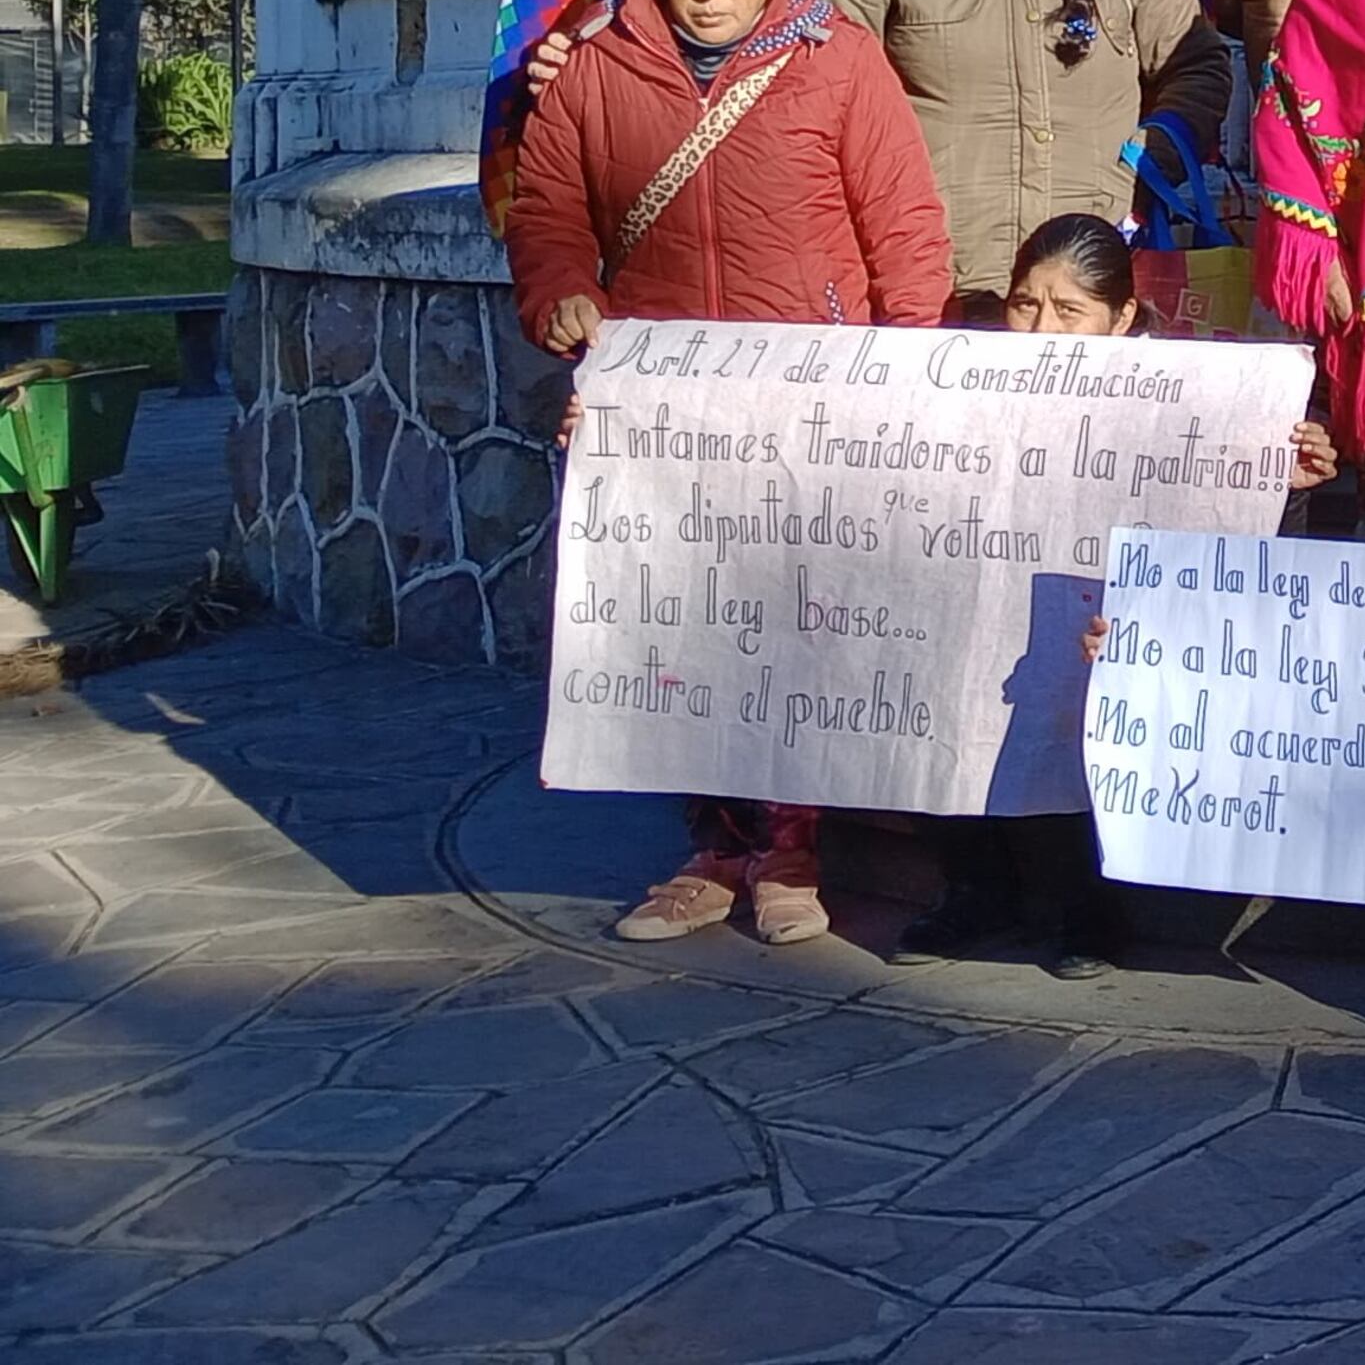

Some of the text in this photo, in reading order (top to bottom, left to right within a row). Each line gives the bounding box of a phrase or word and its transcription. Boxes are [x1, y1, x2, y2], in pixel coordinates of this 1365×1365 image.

[599, 326, 709, 378] Art.
[783, 339, 830, 384] de
[846, 328, 891, 385] la
[926, 333, 1184, 405] Constitución
[585, 402, 779, 464] Infames
[802, 401, 992, 476] traidores
[1019, 447, 1046, 478] a
[1073, 415, 1117, 482] la
[567, 476, 1100, 567] Los diputados que votan a
[570, 580, 617, 624] de
[640, 563, 681, 626] la
[705, 567, 764, 655] ley
[1176, 567, 1199, 591] a
[1213, 537, 1245, 594] la
[1258, 541, 1311, 620] ley
[563, 645, 935, 749] contra el pueblo.
[1181, 645, 1205, 675] a
[1220, 619, 1258, 679] la
[1279, 624, 1339, 715] ley
[1169, 689, 1209, 752] al
